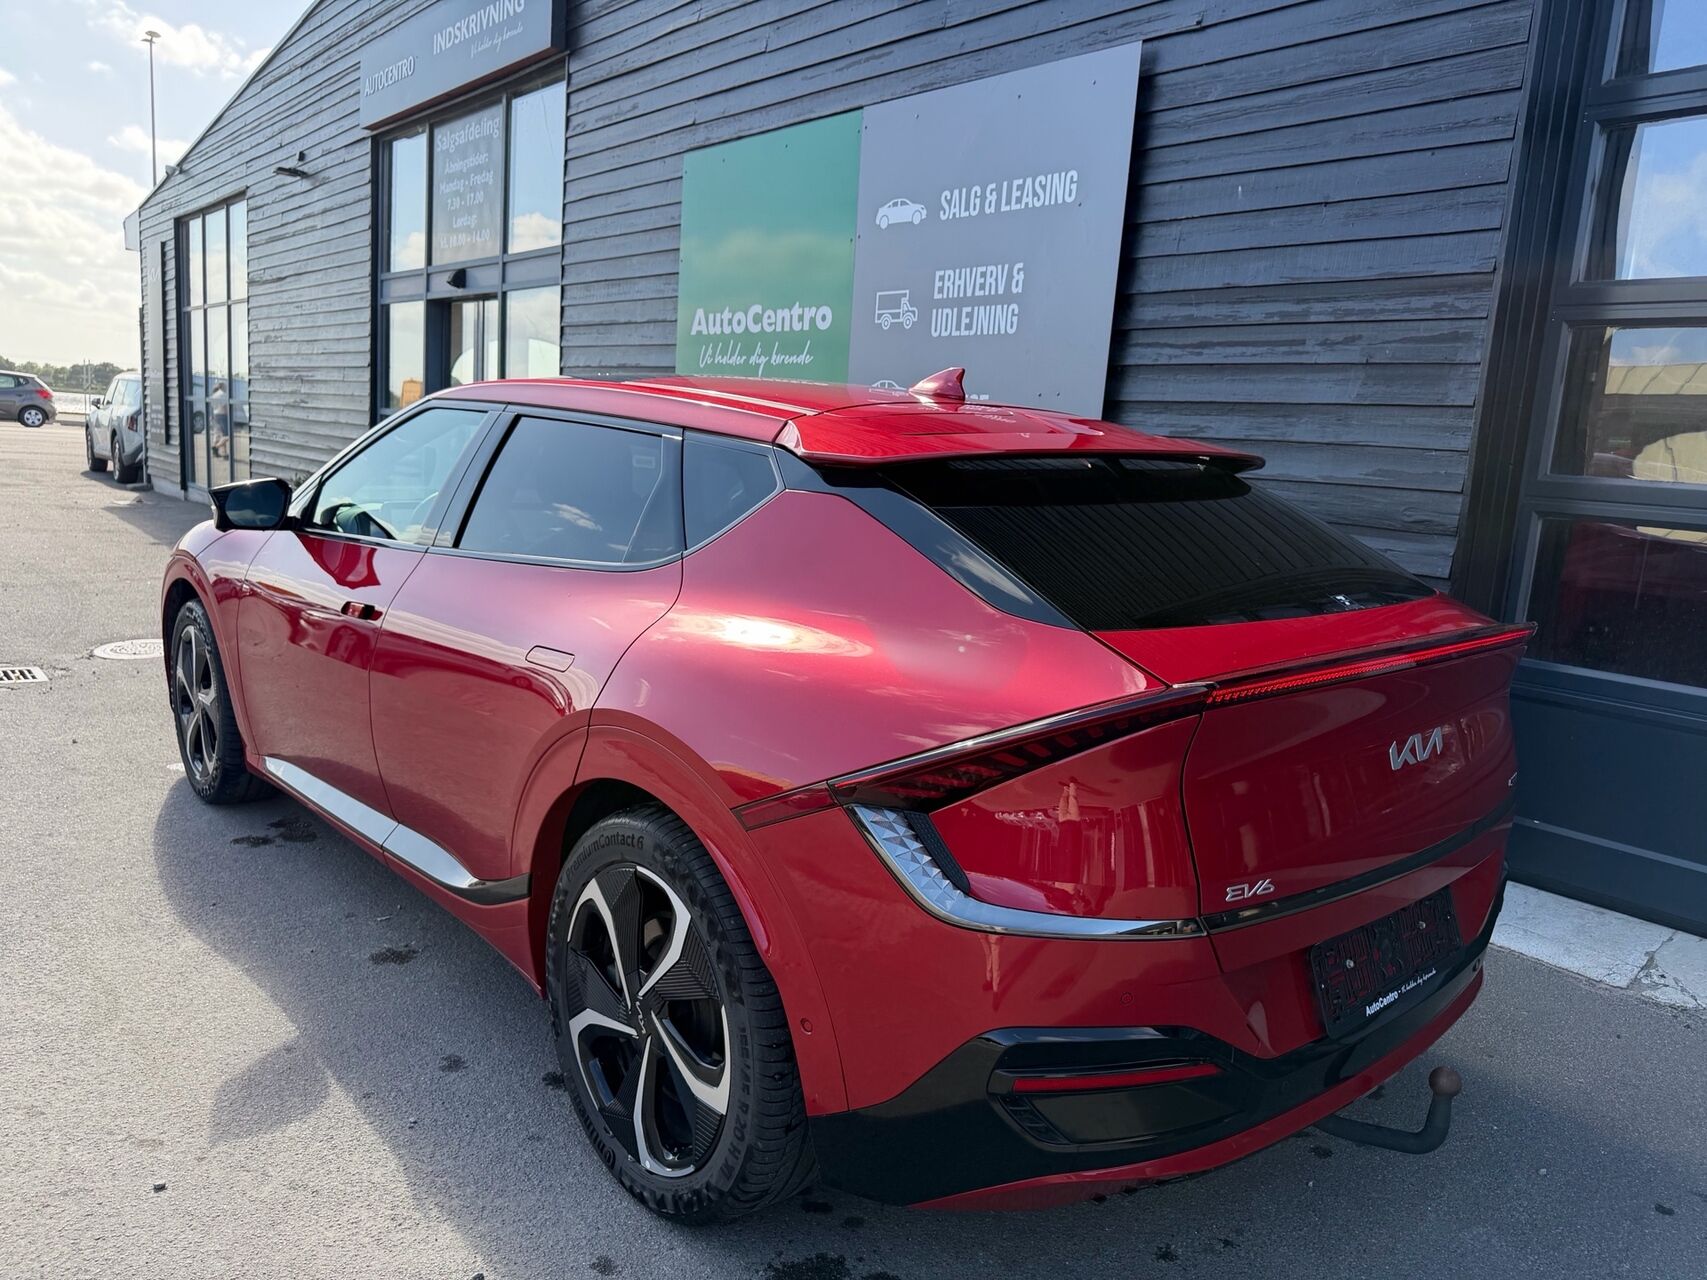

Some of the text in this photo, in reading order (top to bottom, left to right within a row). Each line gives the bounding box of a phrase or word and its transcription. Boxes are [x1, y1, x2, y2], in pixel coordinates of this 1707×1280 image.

[433, 0, 525, 55] INDSKRIVNING
[365, 56, 415, 97] AUTOCENTRO
[436, 117, 500, 152] Salgsafdeling
[439, 178, 464, 194] Mandag
[470, 170, 494, 187] Fredag
[940, 170, 1078, 221] SALG & LEASING
[934, 262, 1024, 299] ERHVERV &
[690, 301, 833, 336] AutoCentro
[931, 303, 1019, 338] UDLEJNING
[700, 339, 814, 377] Vi holder dig kørende
[636, 835, 645, 850] 6
[1225, 878, 1275, 902] EV6
[1365, 991, 1399, 1017] AutoCentro
